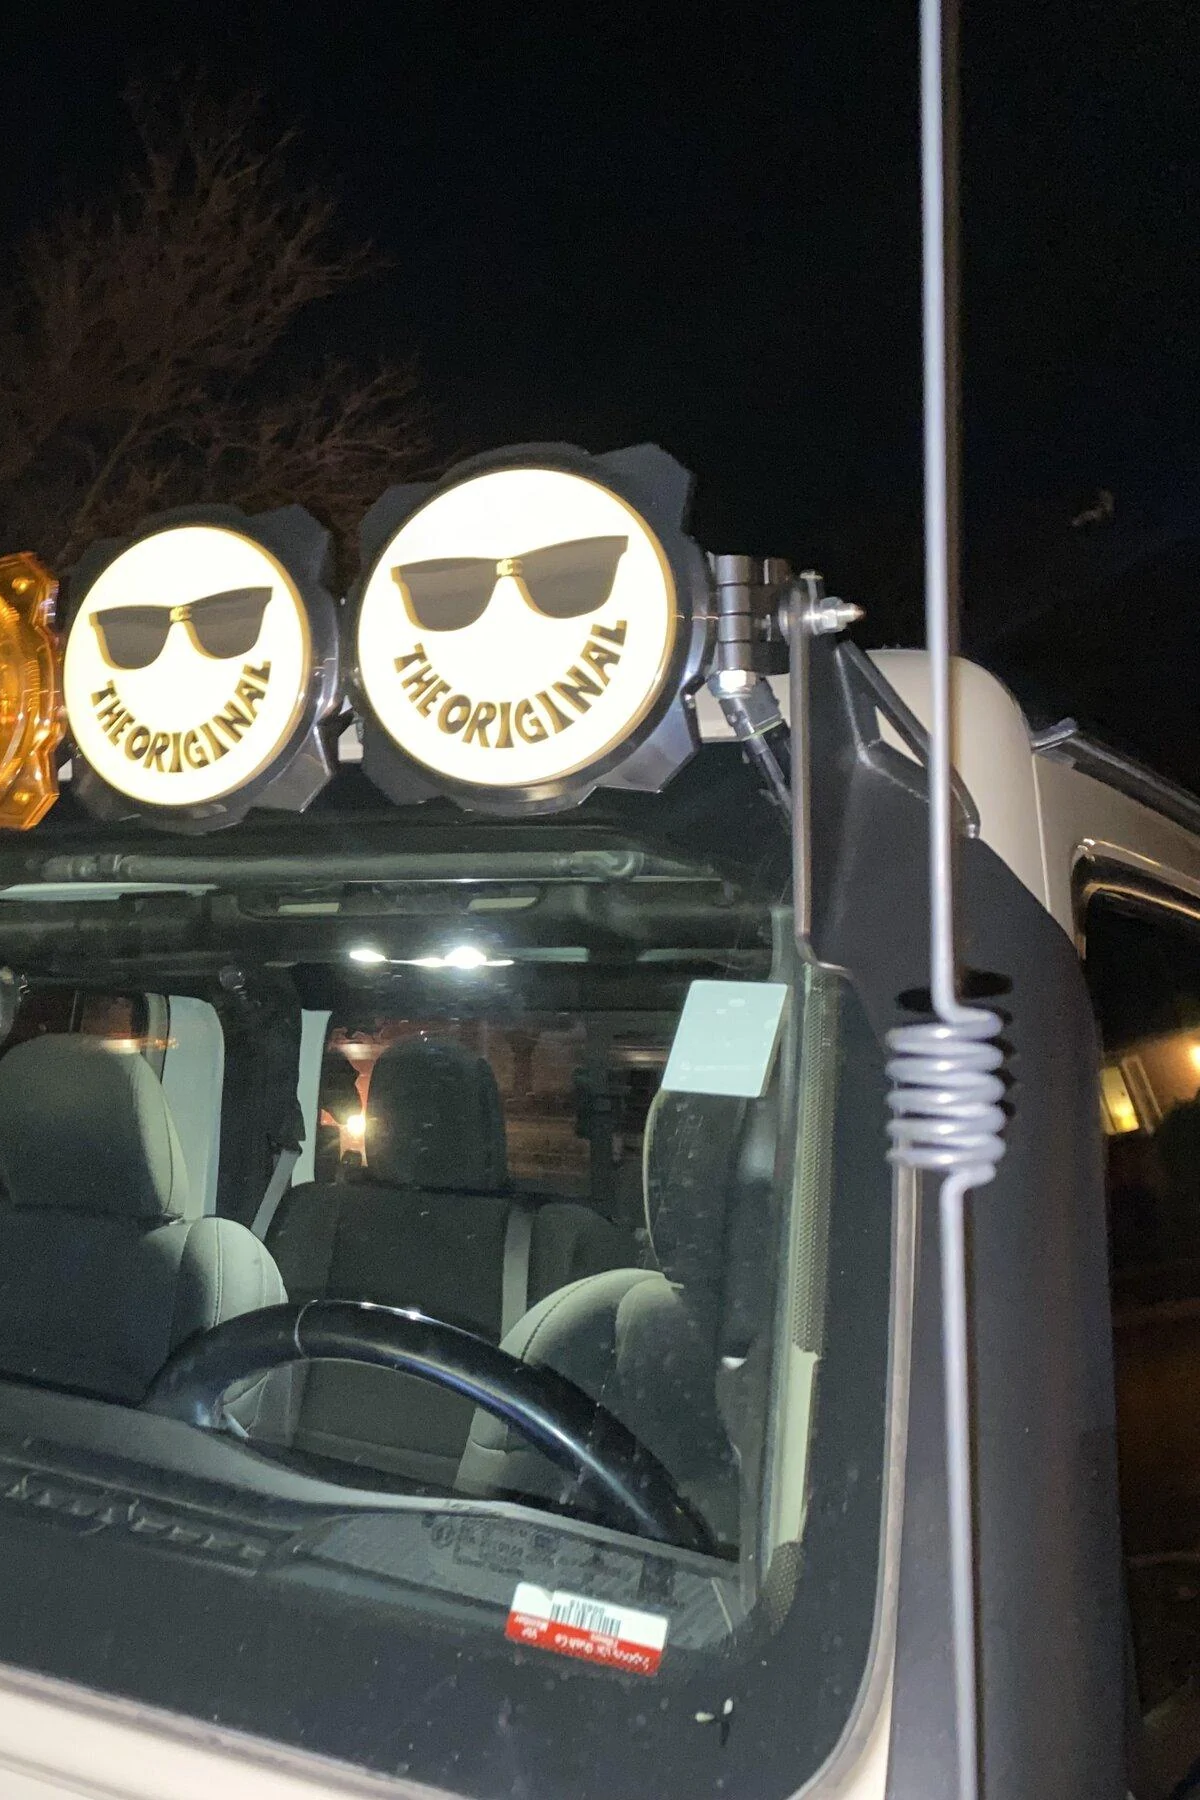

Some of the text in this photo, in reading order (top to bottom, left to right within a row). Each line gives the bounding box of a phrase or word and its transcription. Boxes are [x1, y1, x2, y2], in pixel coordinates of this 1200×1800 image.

[91, 661, 272, 773] THE ORIGINAL
[394, 620, 628, 748] THE ORIGINAL
